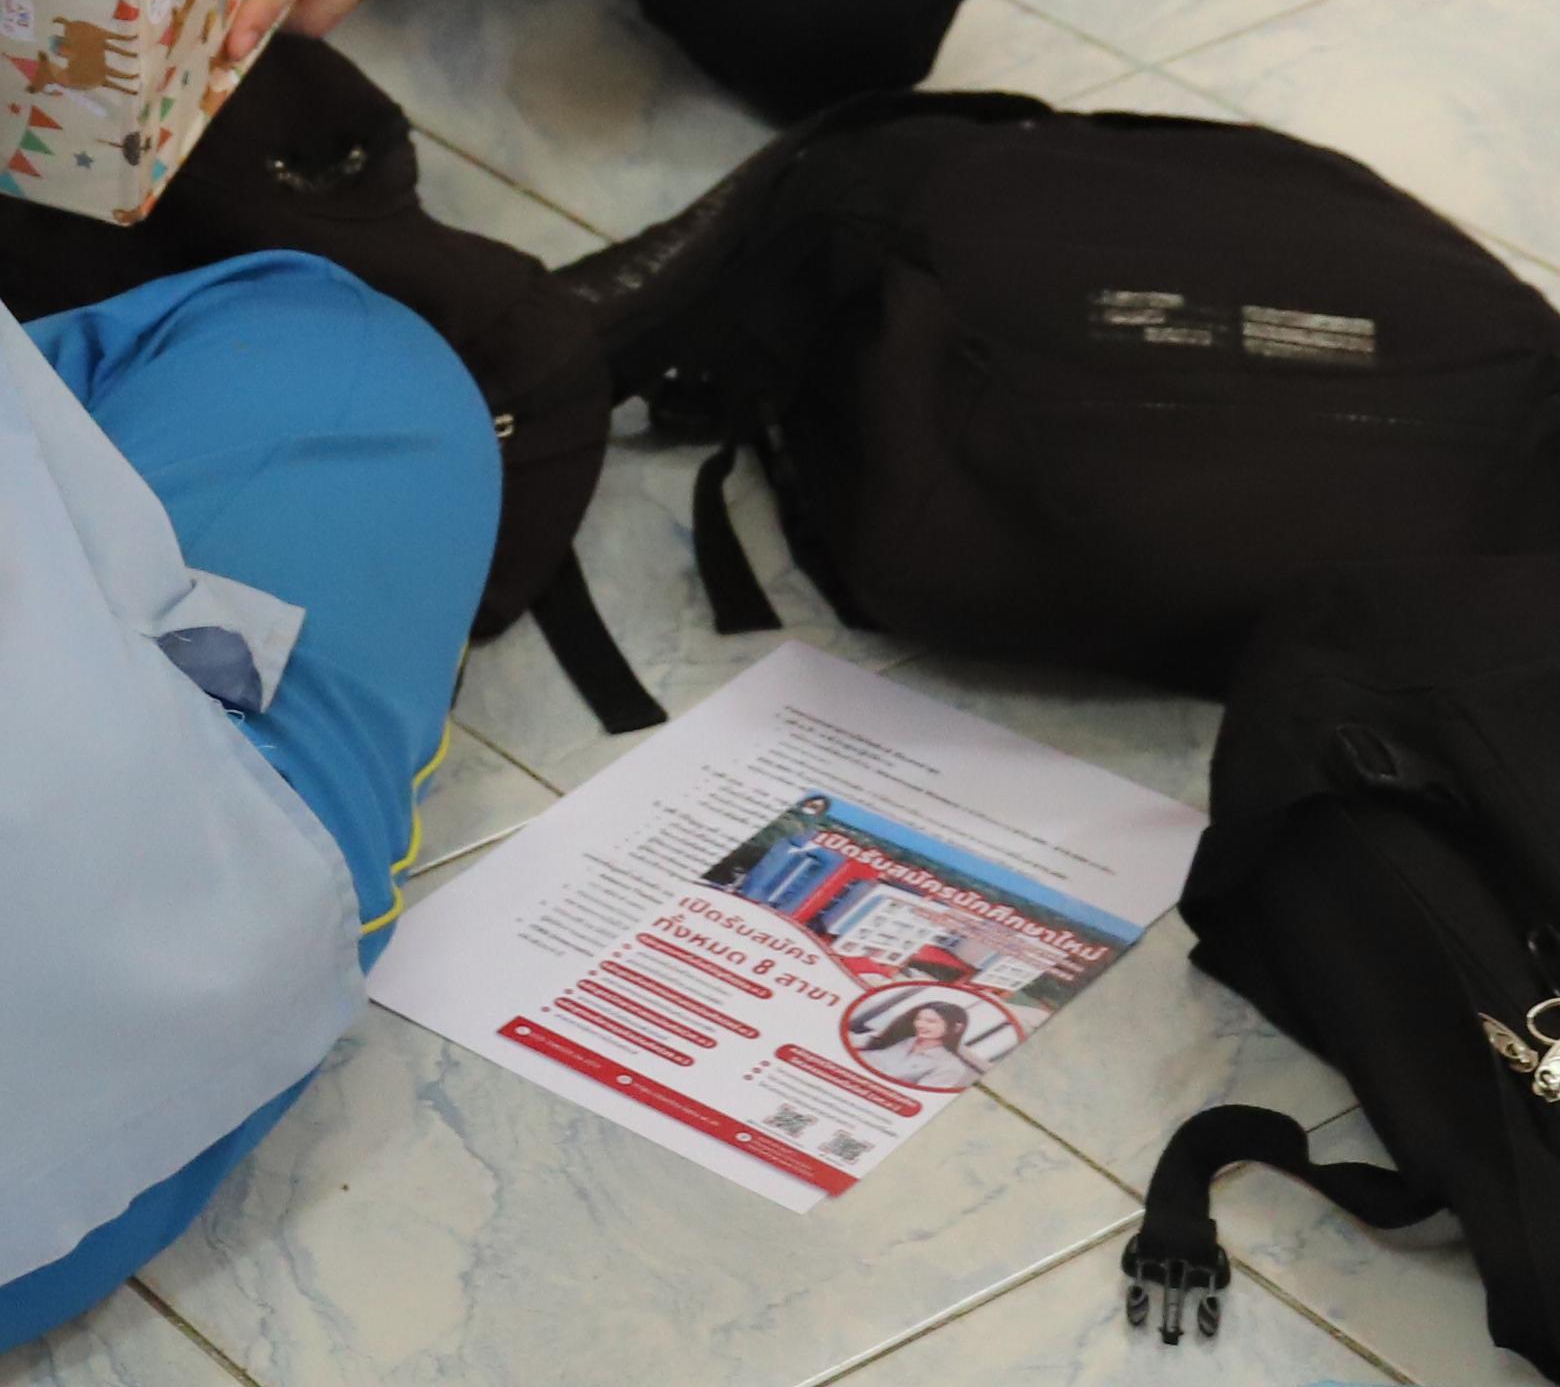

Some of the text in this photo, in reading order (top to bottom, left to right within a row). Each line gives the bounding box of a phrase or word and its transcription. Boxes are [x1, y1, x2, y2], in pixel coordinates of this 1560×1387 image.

[679, 895, 821, 966] เปิดรับสมัคร
[814, 829, 1110, 963] เปิดรับสมัครนักศึกษาใหม่
[652, 914, 748, 967] ทั้งหมด
[752, 957, 771, 976] 8
[775, 973, 842, 1008] สาขา
